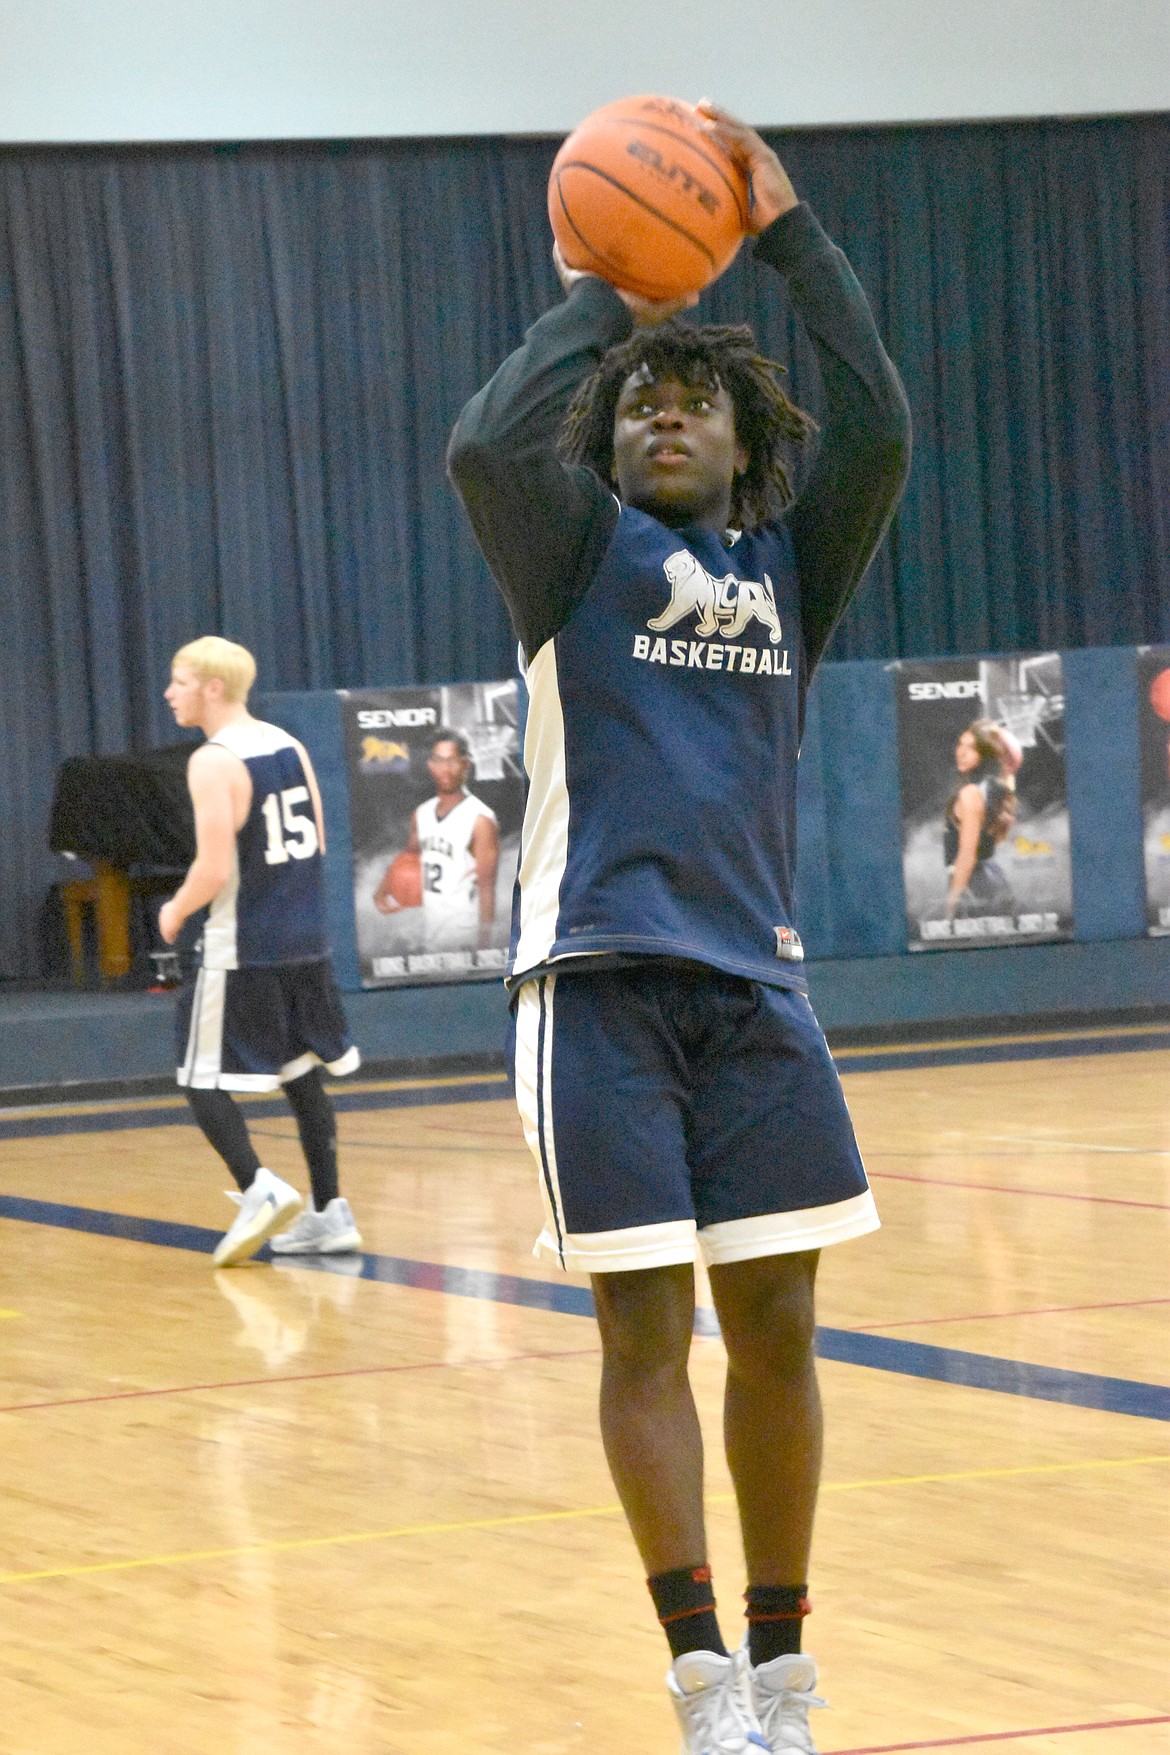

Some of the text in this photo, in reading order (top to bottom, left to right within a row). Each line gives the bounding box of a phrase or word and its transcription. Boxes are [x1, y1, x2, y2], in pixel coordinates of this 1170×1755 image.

[632, 634, 792, 676] BASKETBALL
[908, 681, 985, 700] SENIOR
[357, 707, 436, 729] SENIOR
[261, 785, 318, 865] 15
